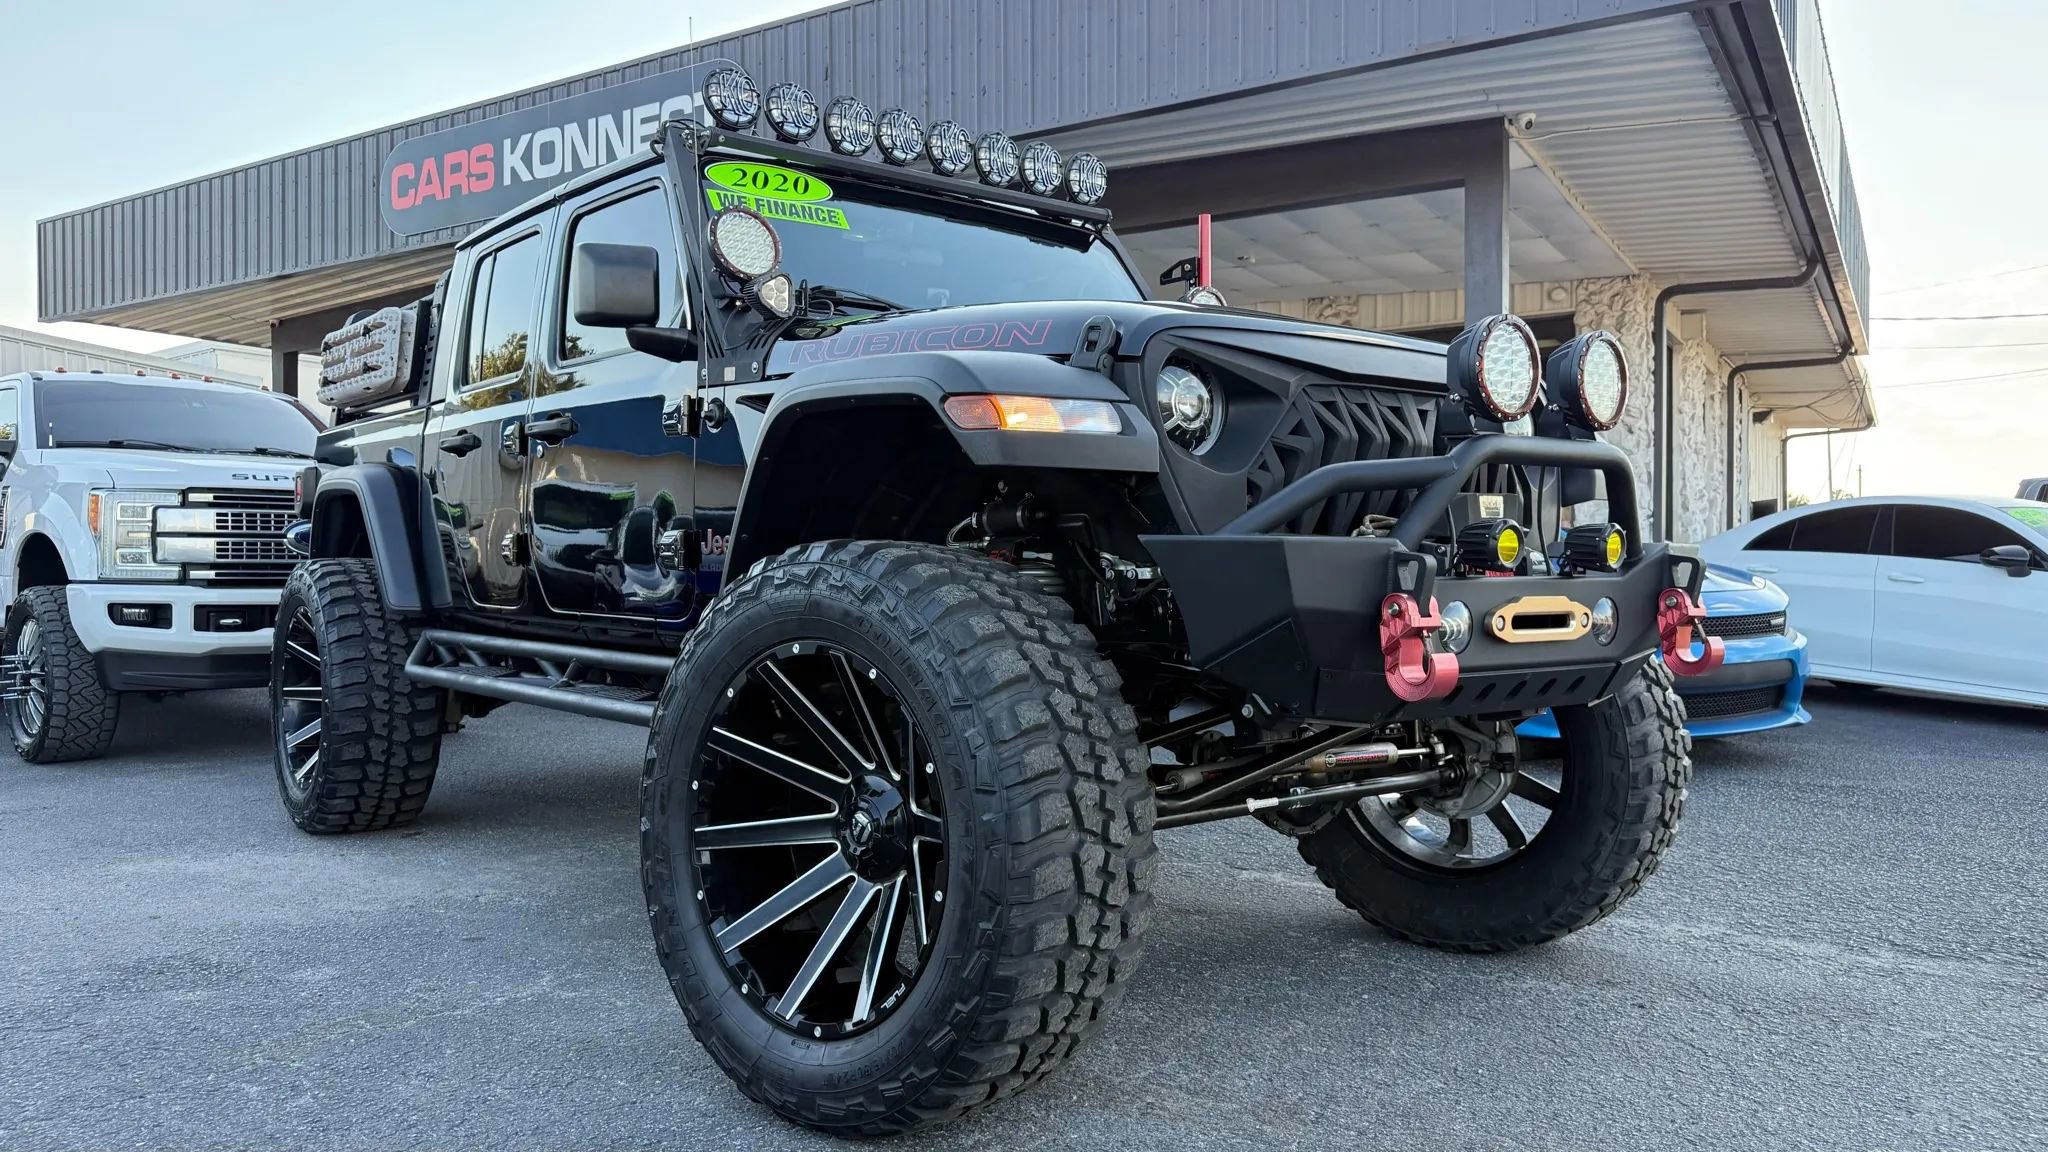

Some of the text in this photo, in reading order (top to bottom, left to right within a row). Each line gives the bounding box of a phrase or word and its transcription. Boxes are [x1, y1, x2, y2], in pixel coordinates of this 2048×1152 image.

[719, 68, 760, 116] KC
[779, 83, 819, 128] KC
[840, 98, 875, 147] KC
[891, 110, 923, 154] KC
[940, 122, 972, 165] KC
[390, 143, 496, 211] CARS
[989, 134, 1019, 177] KC
[1033, 147, 1063, 187] KC
[731, 168, 810, 195] 2020
[1079, 158, 1108, 198] KC
[716, 192, 839, 225] WE FINANCE
[787, 319, 1053, 365] RUBICON
[880, 982, 906, 1009] FUEL
